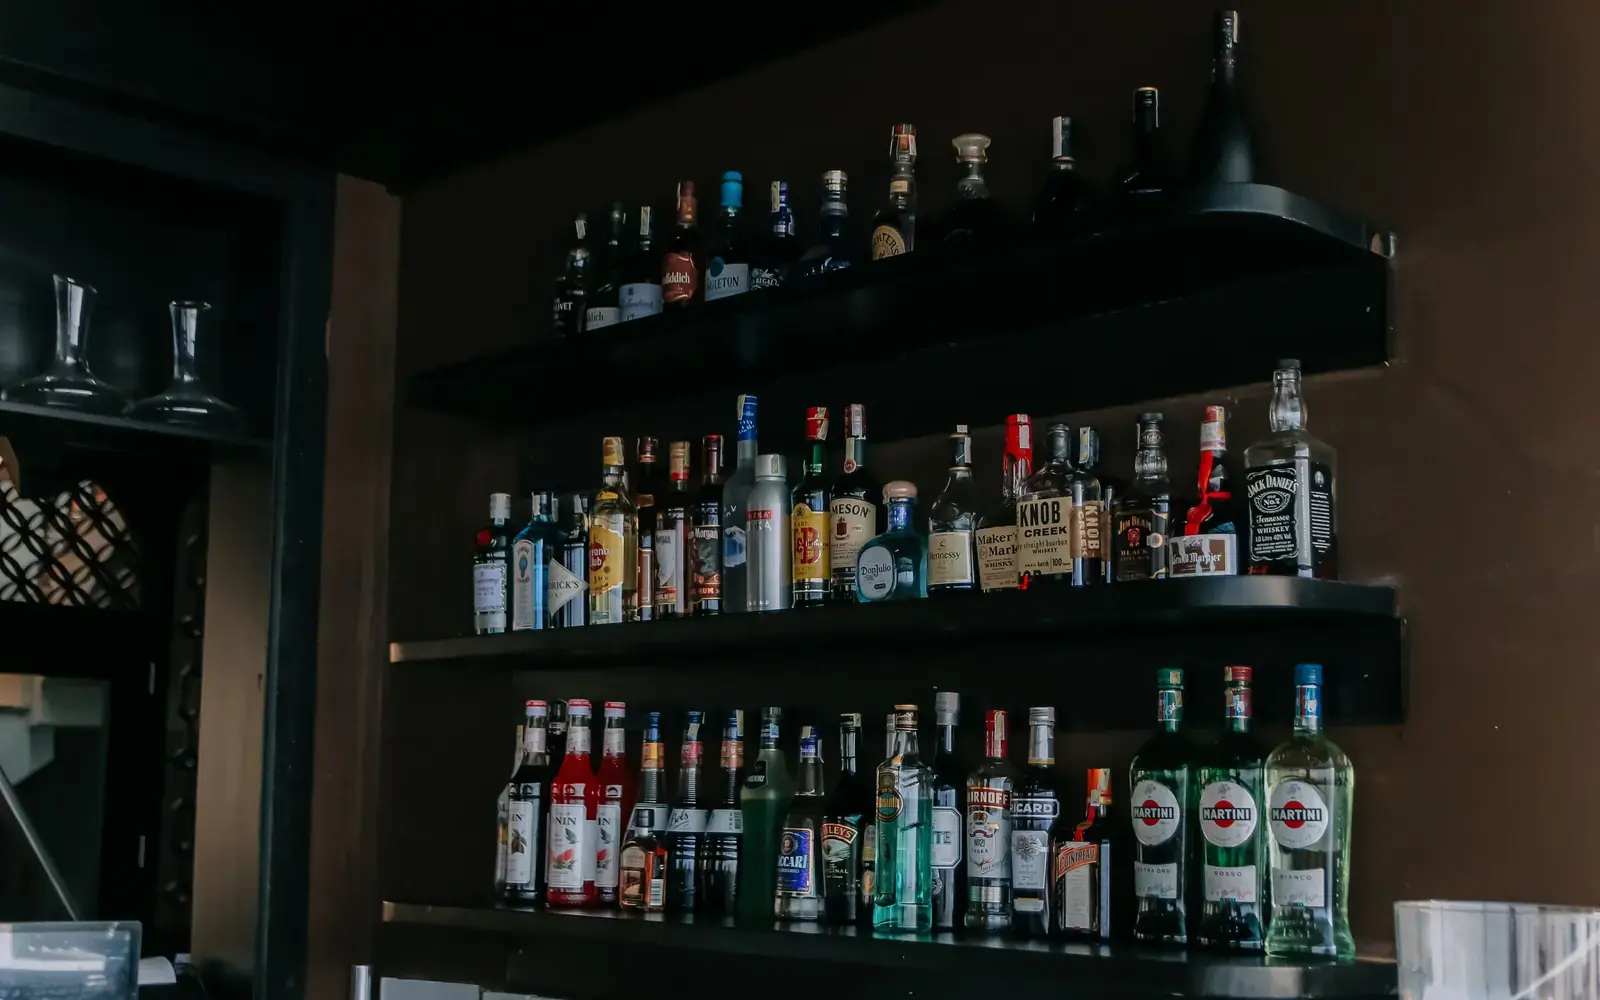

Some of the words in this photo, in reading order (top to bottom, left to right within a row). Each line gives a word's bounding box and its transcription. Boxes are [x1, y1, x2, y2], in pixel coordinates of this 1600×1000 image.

[1247, 479, 1267, 498] JACK
[1266, 474, 1299, 494] DANIEL'S
[1020, 501, 1061, 527] KNOB
[1256, 515, 1290, 523] Tennessee
[1024, 526, 1068, 538] CREEK
[1084, 505, 1100, 550] KNOB
[1257, 526, 1290, 534] WHISKEY
[984, 560, 1014, 569] WHISKY
[1052, 558, 1063, 567] 100
[1134, 807, 1174, 819] MARTINI
[1203, 808, 1250, 820] MARTINI
[1272, 808, 1322, 821] MARTINI
